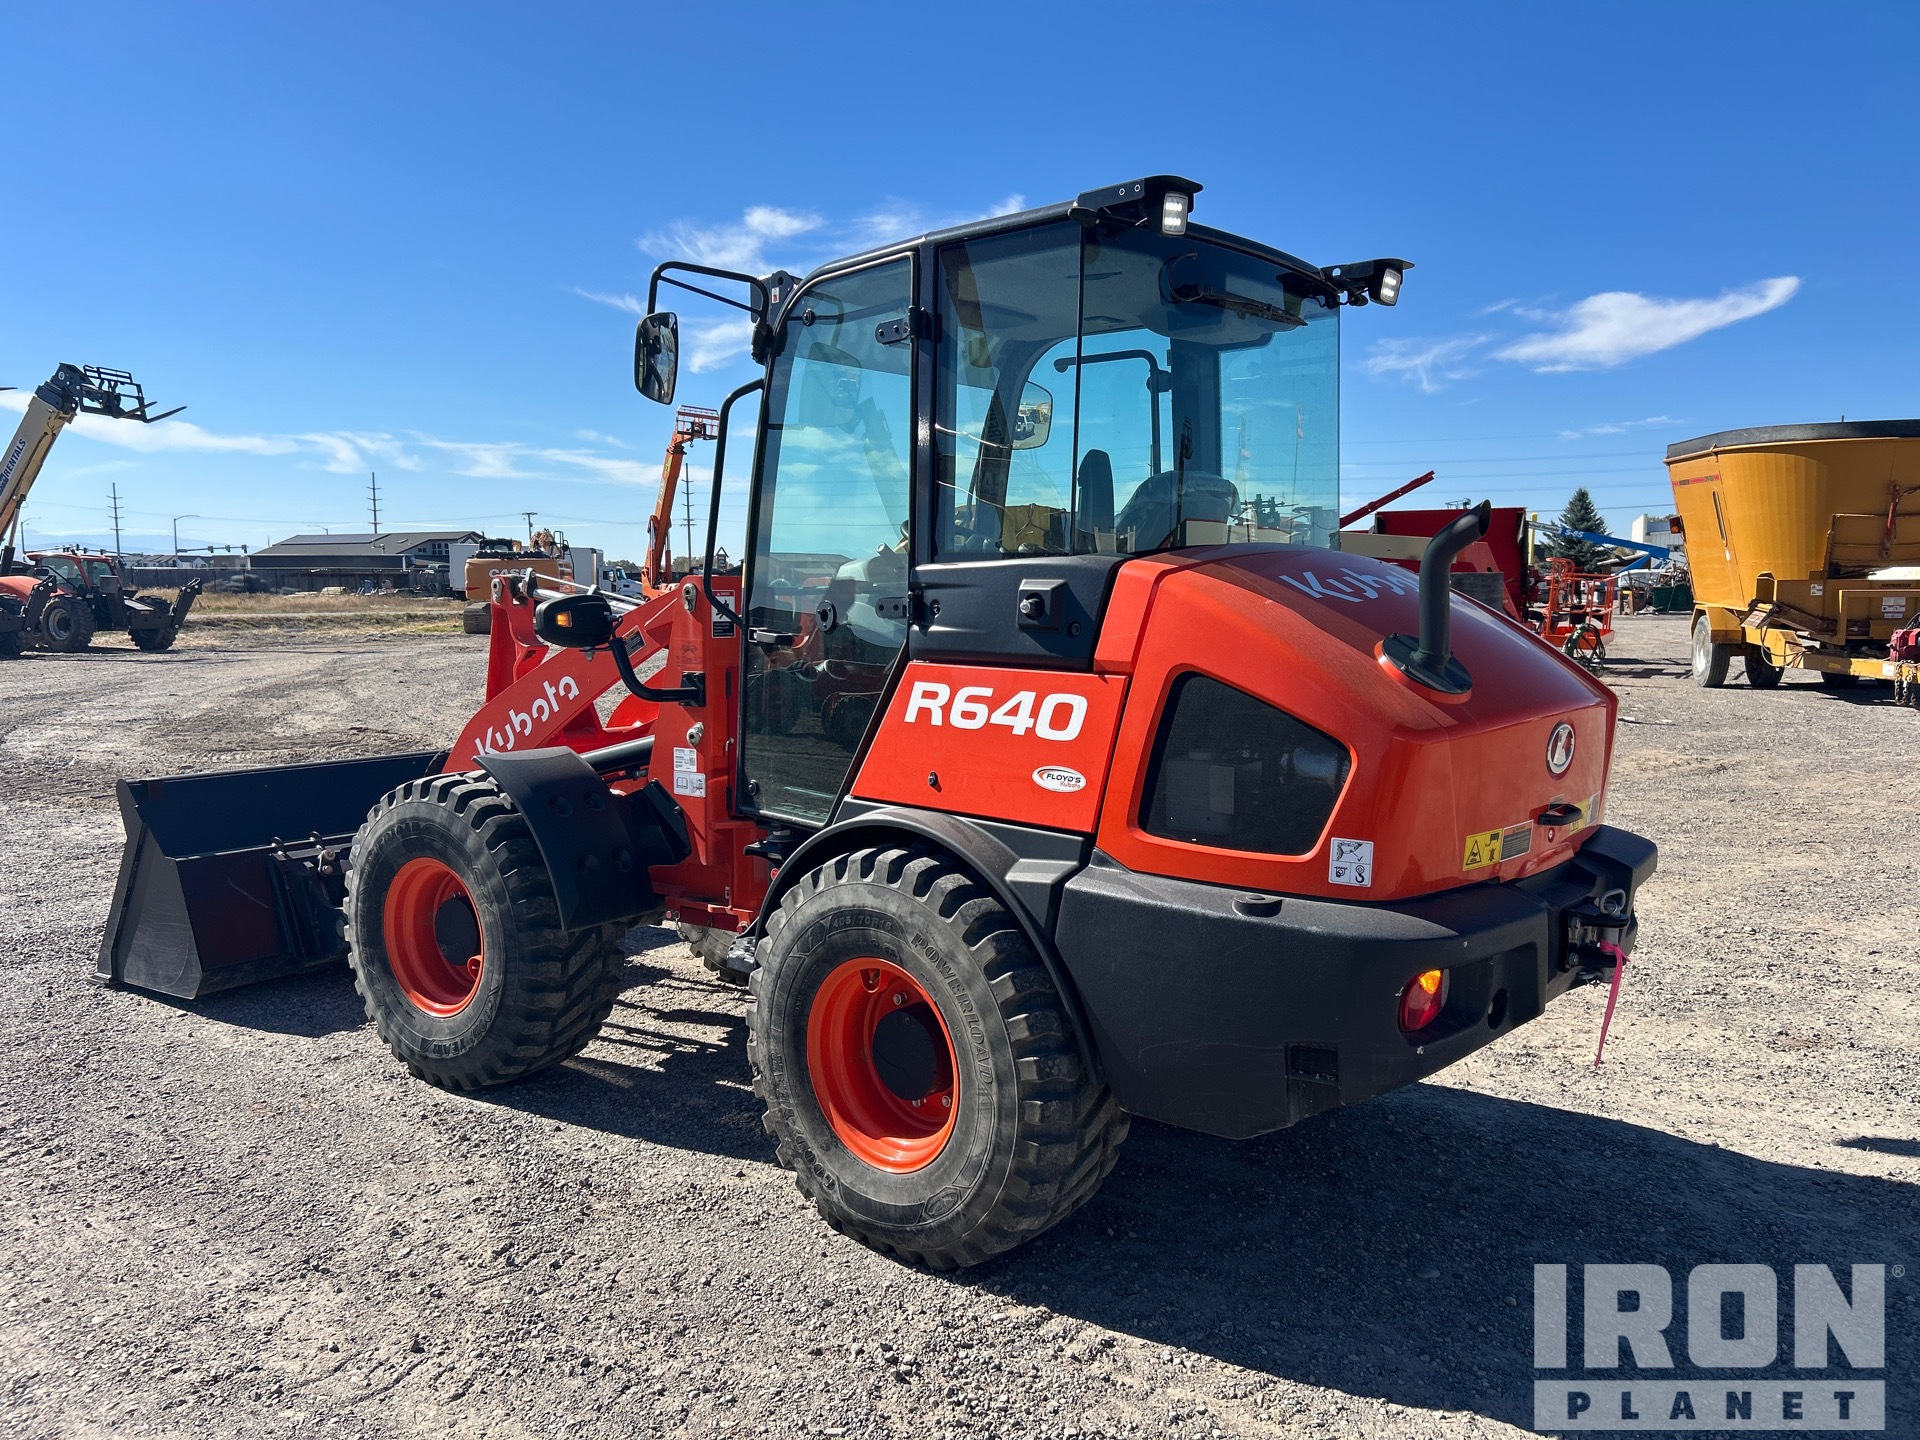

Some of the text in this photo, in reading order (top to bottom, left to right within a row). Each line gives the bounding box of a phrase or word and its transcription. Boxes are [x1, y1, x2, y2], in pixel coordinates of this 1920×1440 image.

[4, 439, 26, 477] RENTALS
[475, 676, 580, 756] Kubota
[904, 681, 1088, 741] R640
[1046, 773, 1081, 783] FLOYD'S
[911, 933, 994, 1084] POWERLOAD
